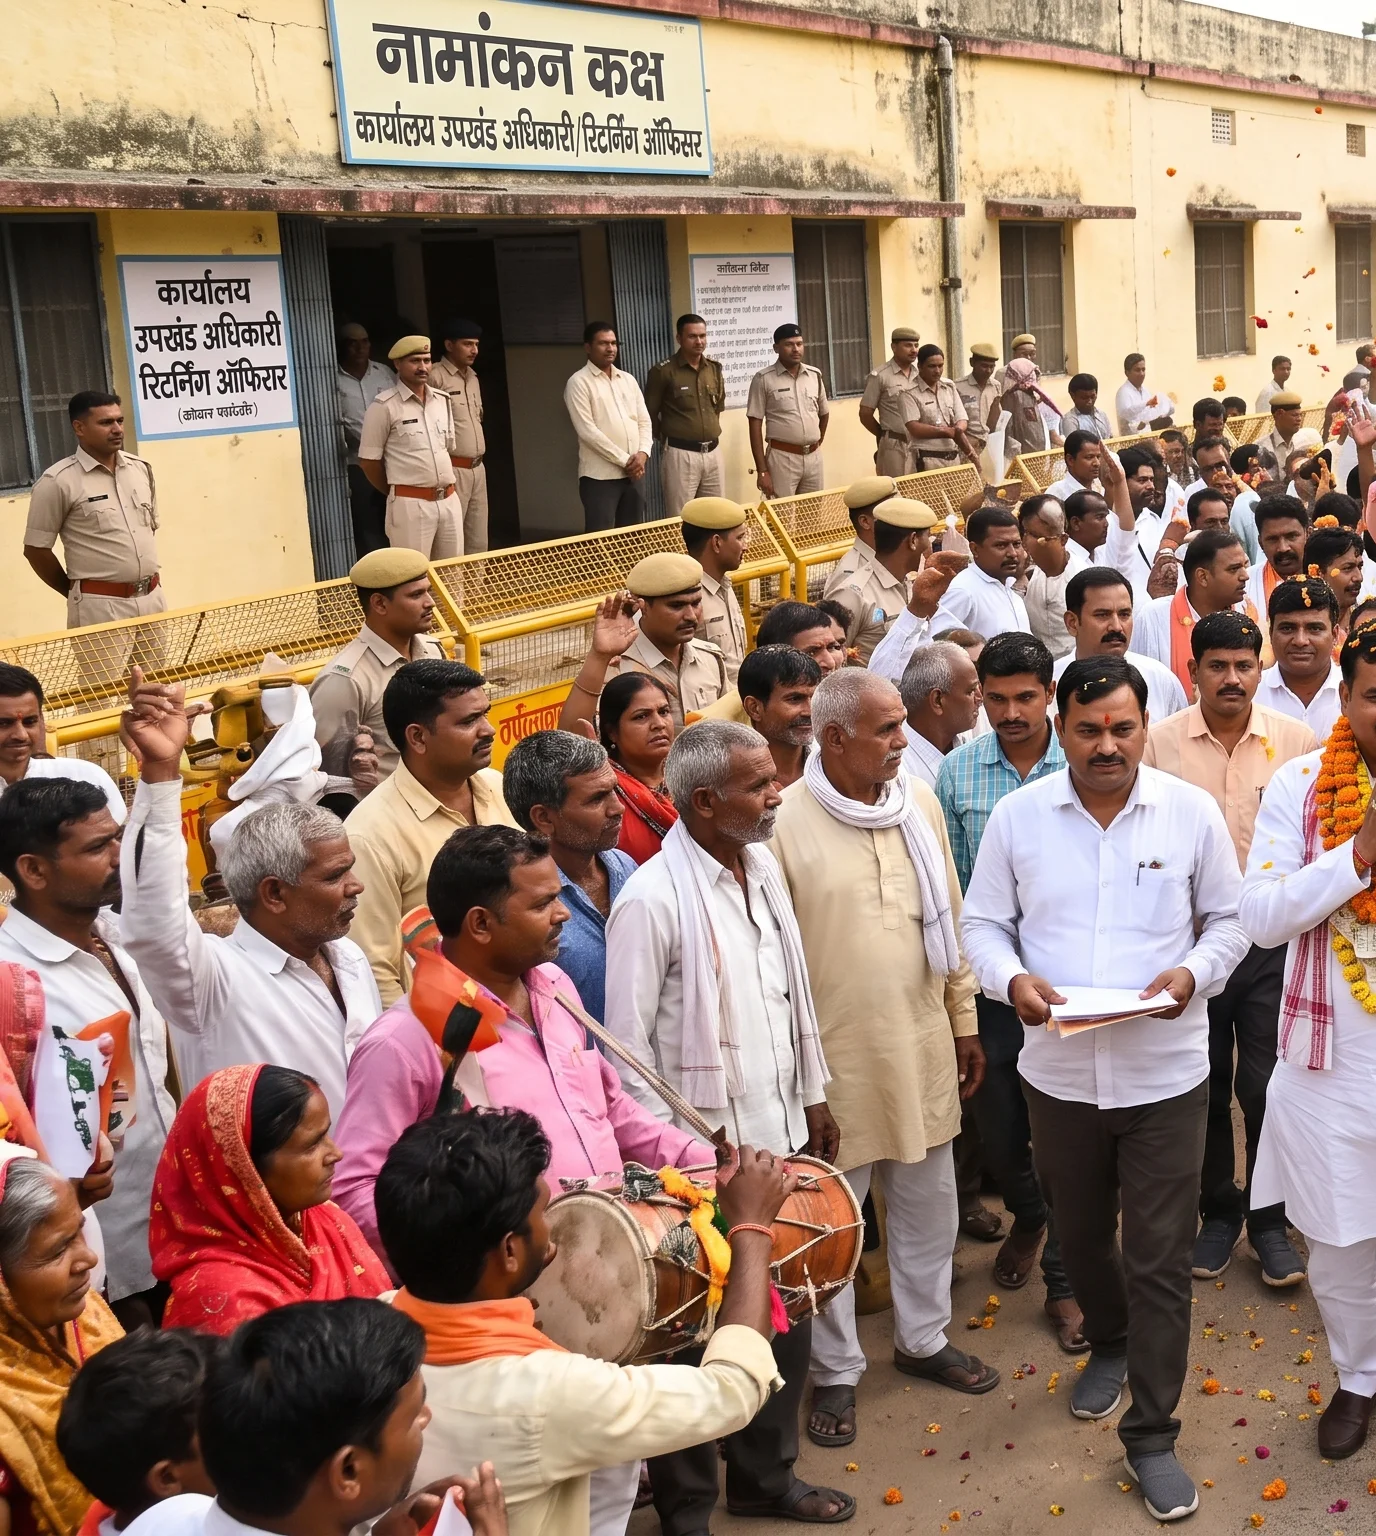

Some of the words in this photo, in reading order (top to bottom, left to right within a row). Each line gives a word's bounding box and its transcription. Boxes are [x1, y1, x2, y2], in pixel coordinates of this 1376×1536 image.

[372, 11, 573, 96] नामांकन
[584, 45, 665, 102] कक्ष
[353, 101, 435, 147] कार्यालय
[439, 106, 498, 151] उपखंड
[643, 117, 703, 158] ऑफिसर
[155, 269, 251, 305] कार्यालय
[134, 315, 197, 353] उपखंड
[203, 310, 281, 350] अधिकारी
